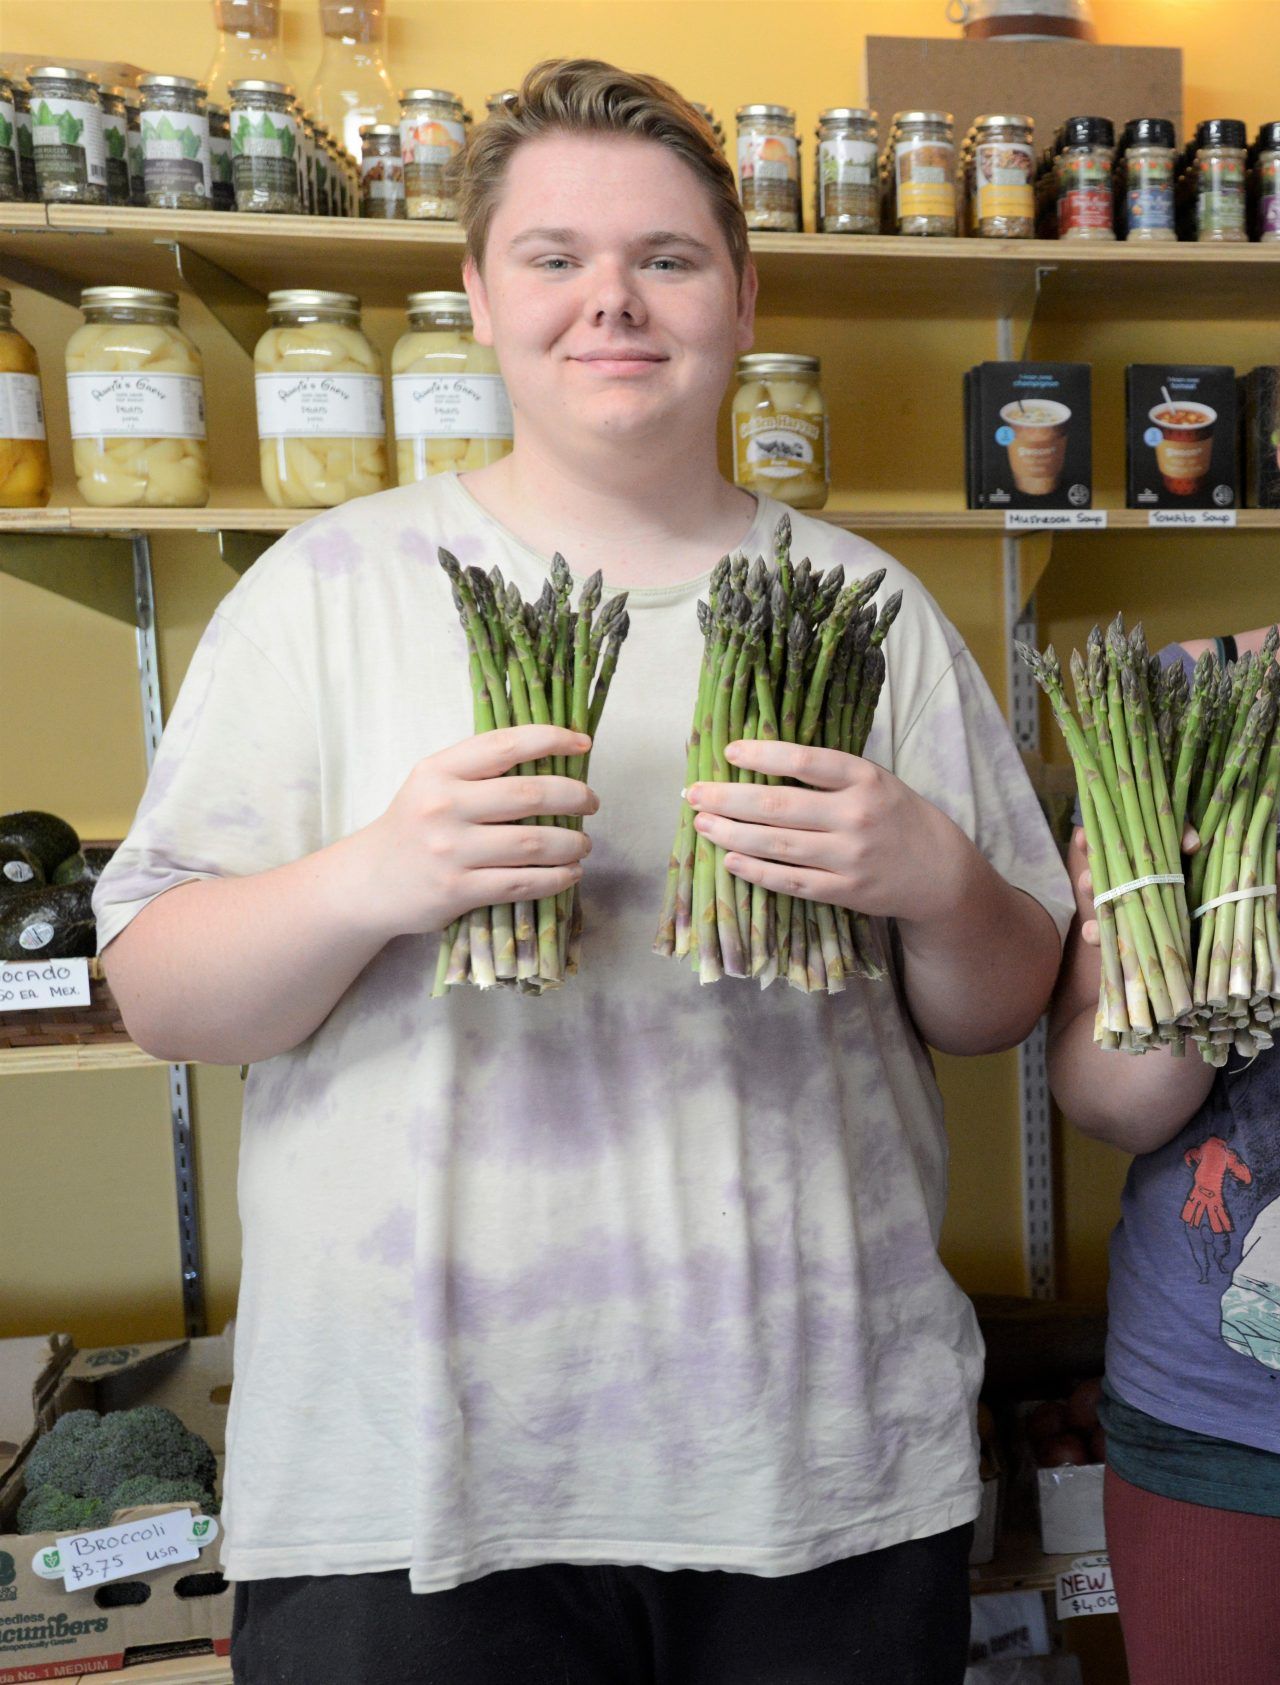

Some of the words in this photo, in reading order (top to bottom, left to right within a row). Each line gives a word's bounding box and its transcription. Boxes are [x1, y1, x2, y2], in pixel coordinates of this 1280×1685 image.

[72, 1554, 125, 1582] $3.75
[1060, 1571, 1107, 1597] NEW
[0, 1612, 109, 1644] cumbers
[53, 1660, 109, 1678] MEDIUM
